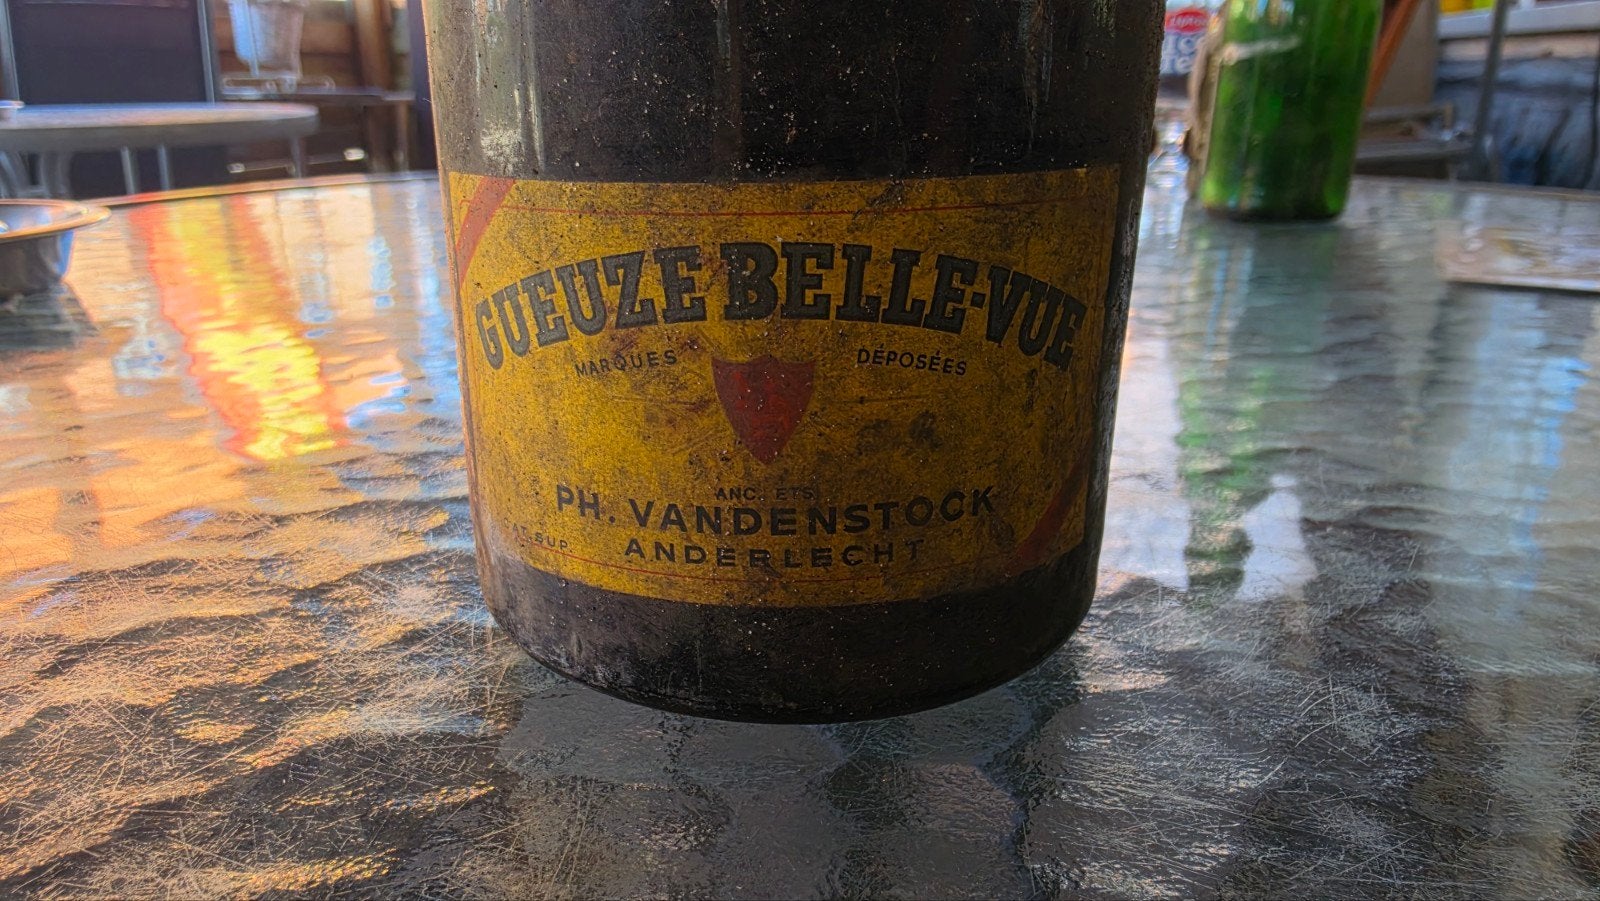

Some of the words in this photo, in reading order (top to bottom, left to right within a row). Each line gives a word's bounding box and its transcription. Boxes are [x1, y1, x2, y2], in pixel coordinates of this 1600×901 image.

[475, 245, 707, 370] GUEUZE
[720, 241, 1087, 371] BELLE-VUE
[575, 350, 677, 378] MARQUES
[857, 344, 967, 376] DÉPOSÉES
[556, 484, 616, 524] PH.
[628, 486, 995, 536] VANDENSTOCK
[625, 538, 924, 568] ANDERLECHT
